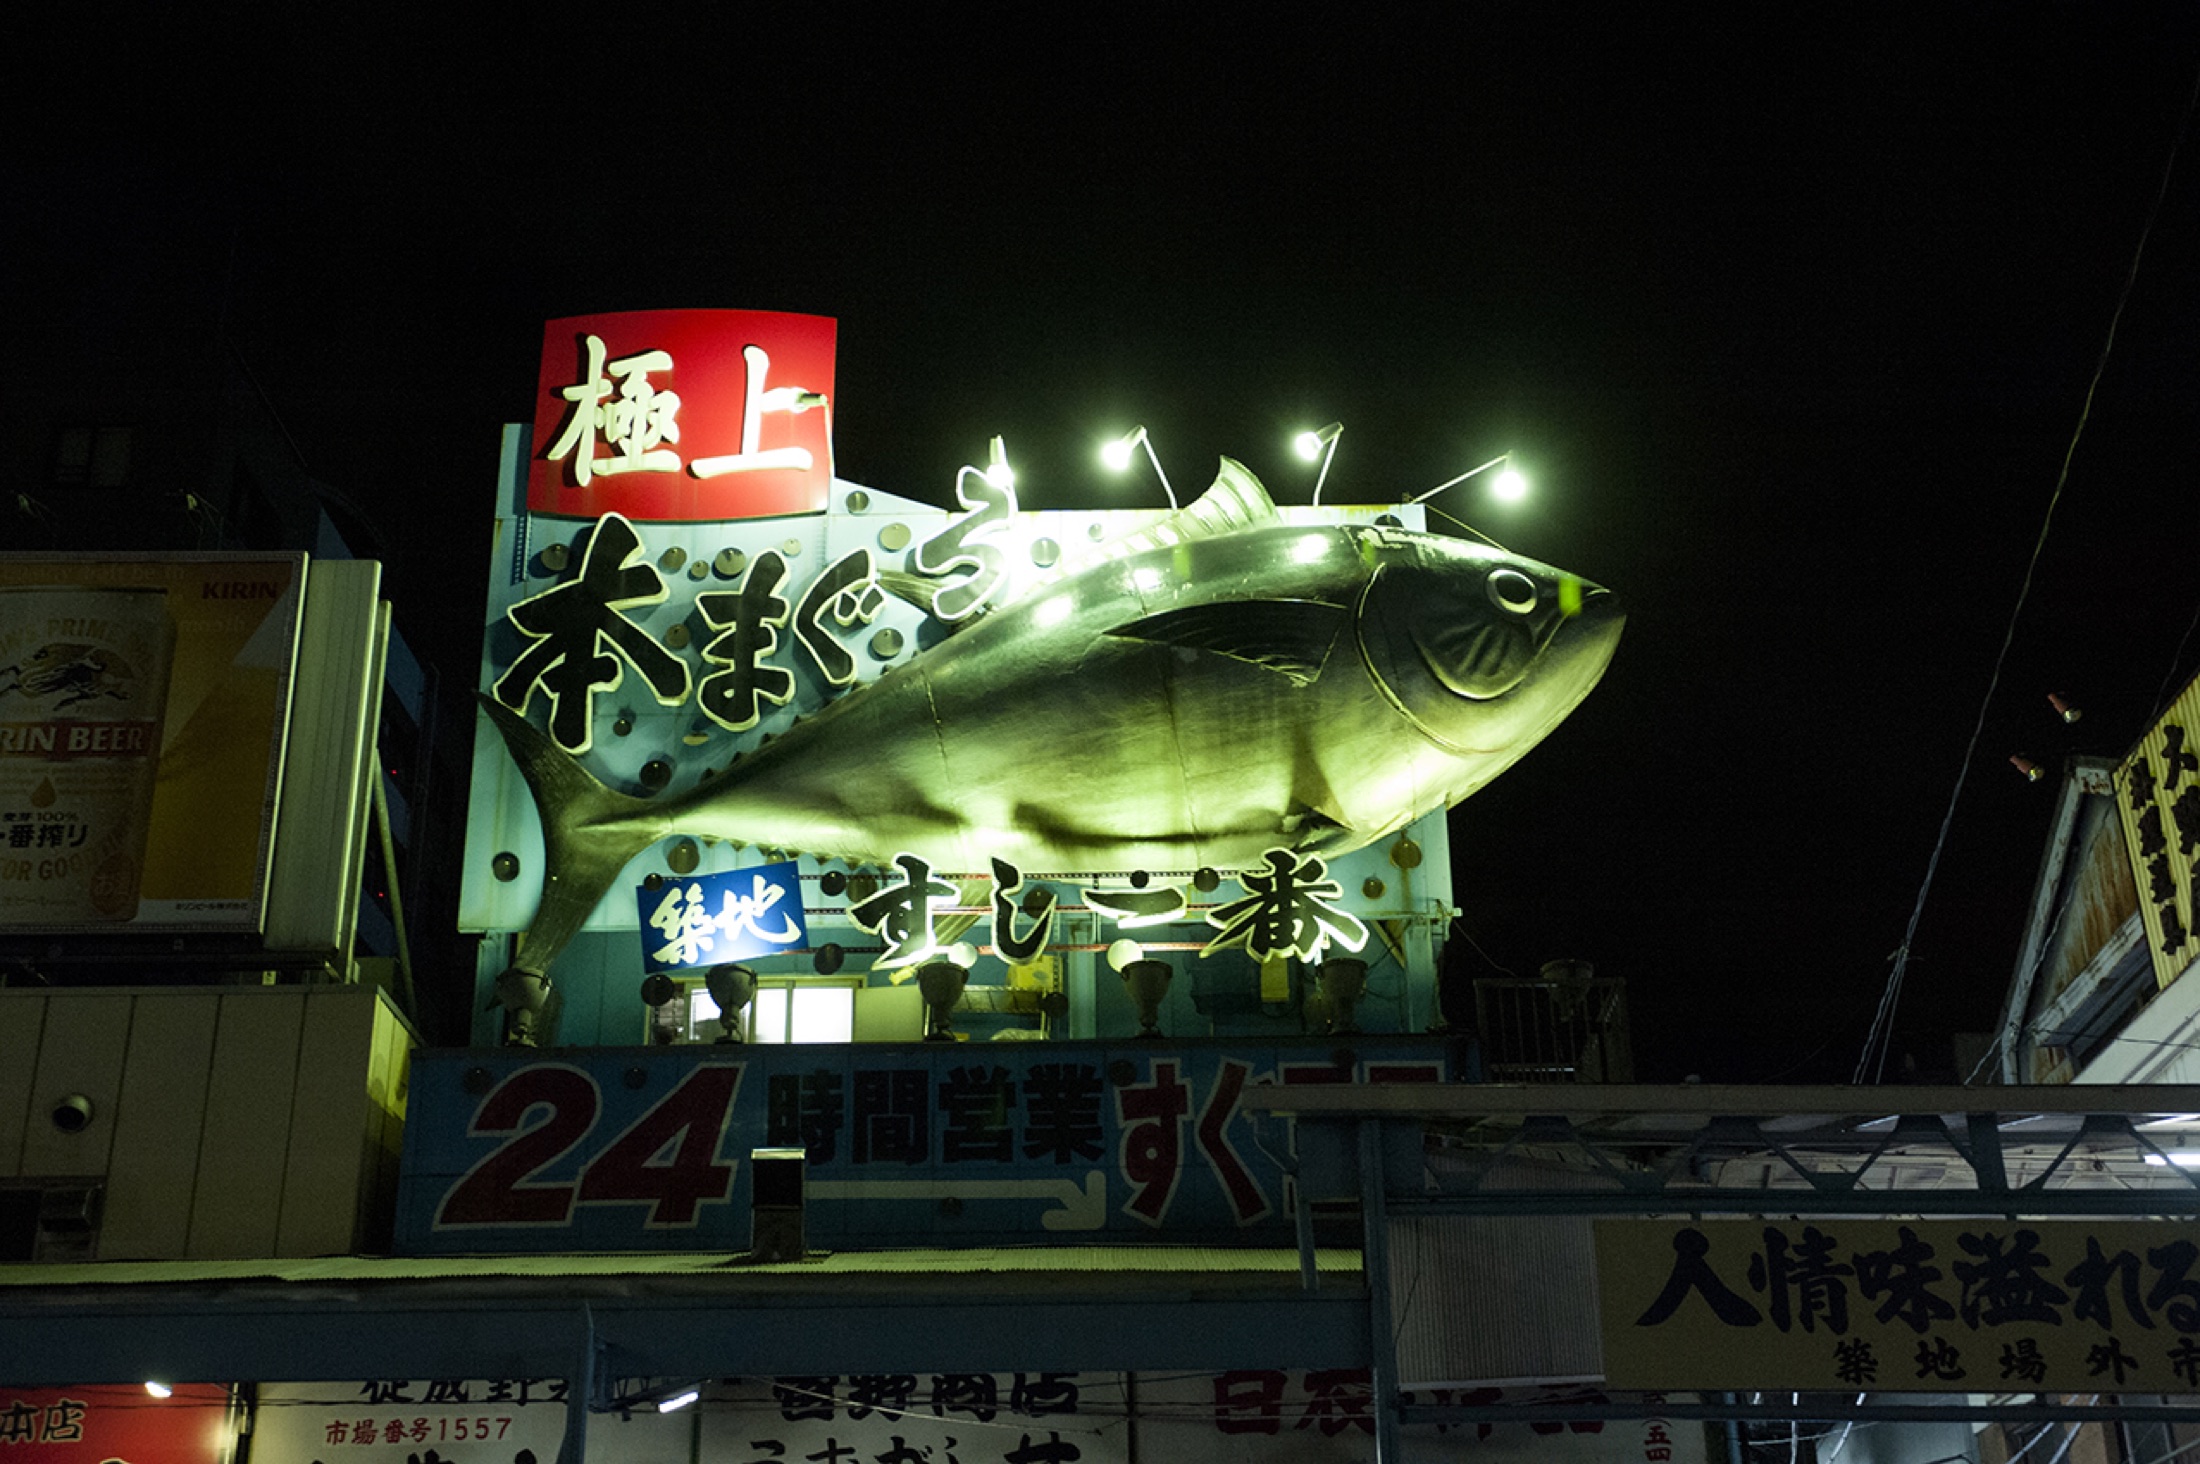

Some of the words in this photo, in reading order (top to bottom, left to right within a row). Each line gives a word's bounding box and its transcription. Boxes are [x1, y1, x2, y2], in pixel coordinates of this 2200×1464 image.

[548, 335, 813, 487] 極上
[202, 581, 279, 599] KIRIN
[494, 465, 1018, 755] 本まぐろ
[68, 726, 143, 752] BEER
[650, 873, 801, 966] 築地
[844, 848, 1369, 971] すし一番
[1635, 1226, 2200, 1334] 人情味溢れる
[325, 1416, 512, 1446] 市場番号1557
